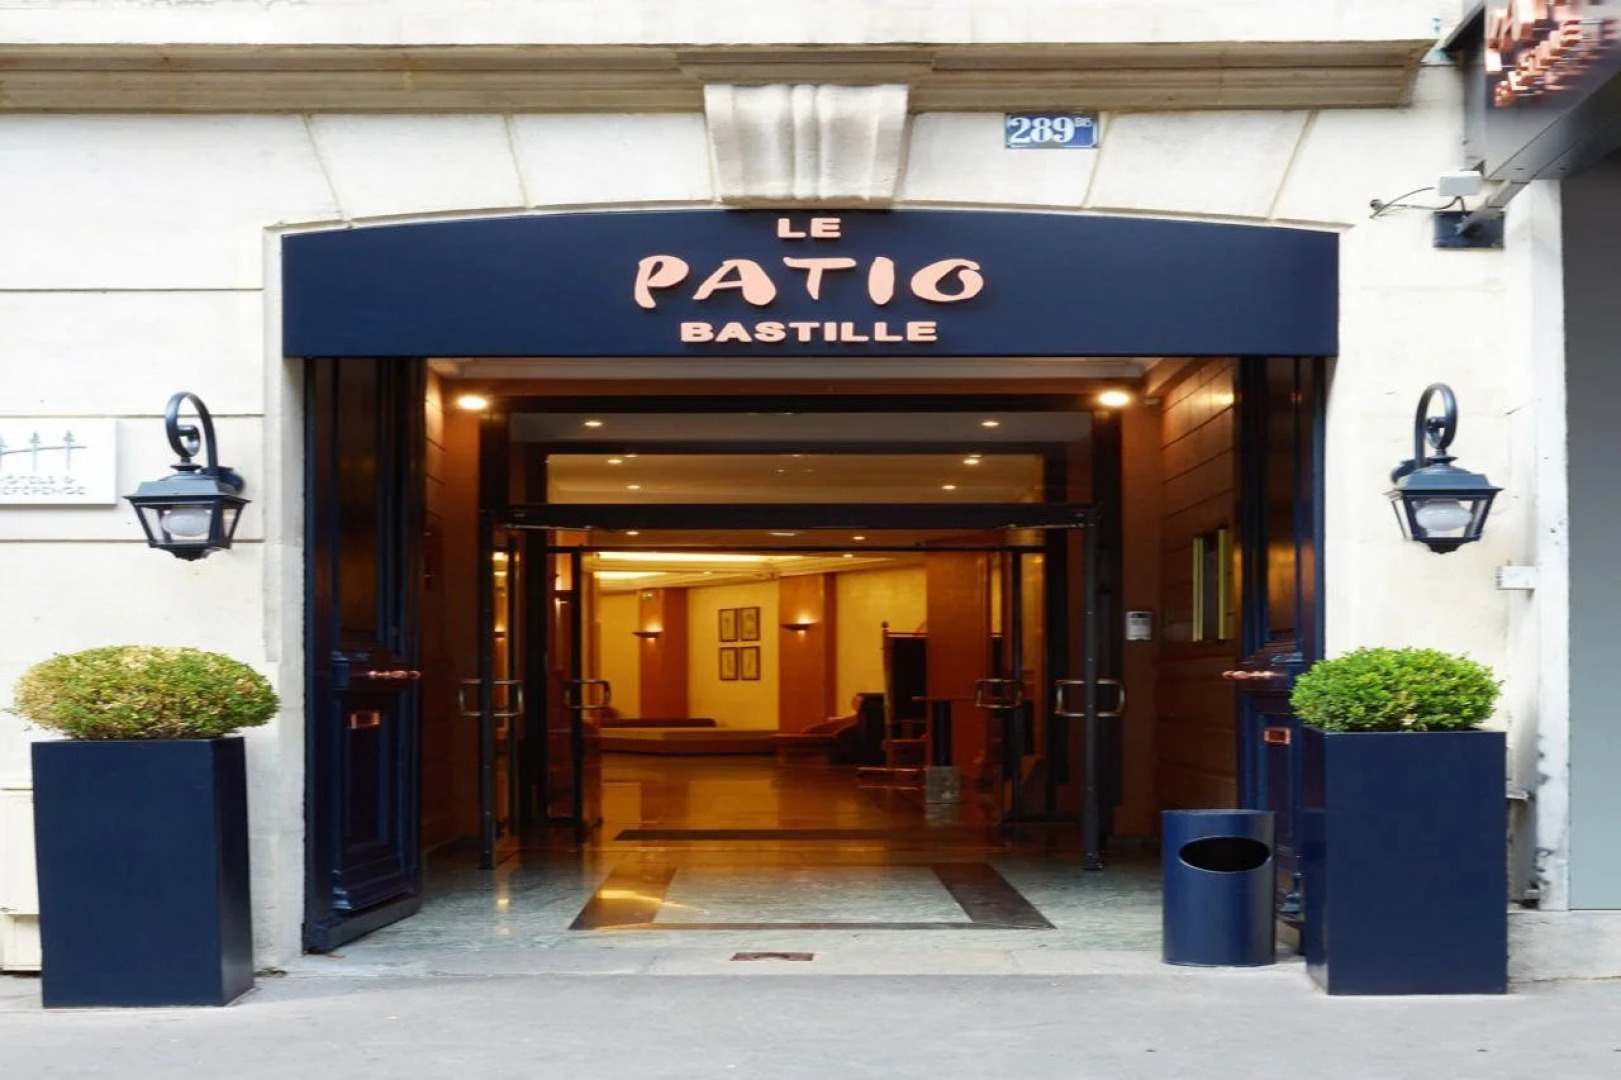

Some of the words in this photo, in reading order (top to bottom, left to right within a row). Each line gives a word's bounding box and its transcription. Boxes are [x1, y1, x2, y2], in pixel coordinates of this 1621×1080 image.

[1007, 117, 1075, 143] 289
[778, 218, 841, 237] LE
[635, 255, 983, 308] PATIO
[681, 322, 937, 342] BASTILLE
